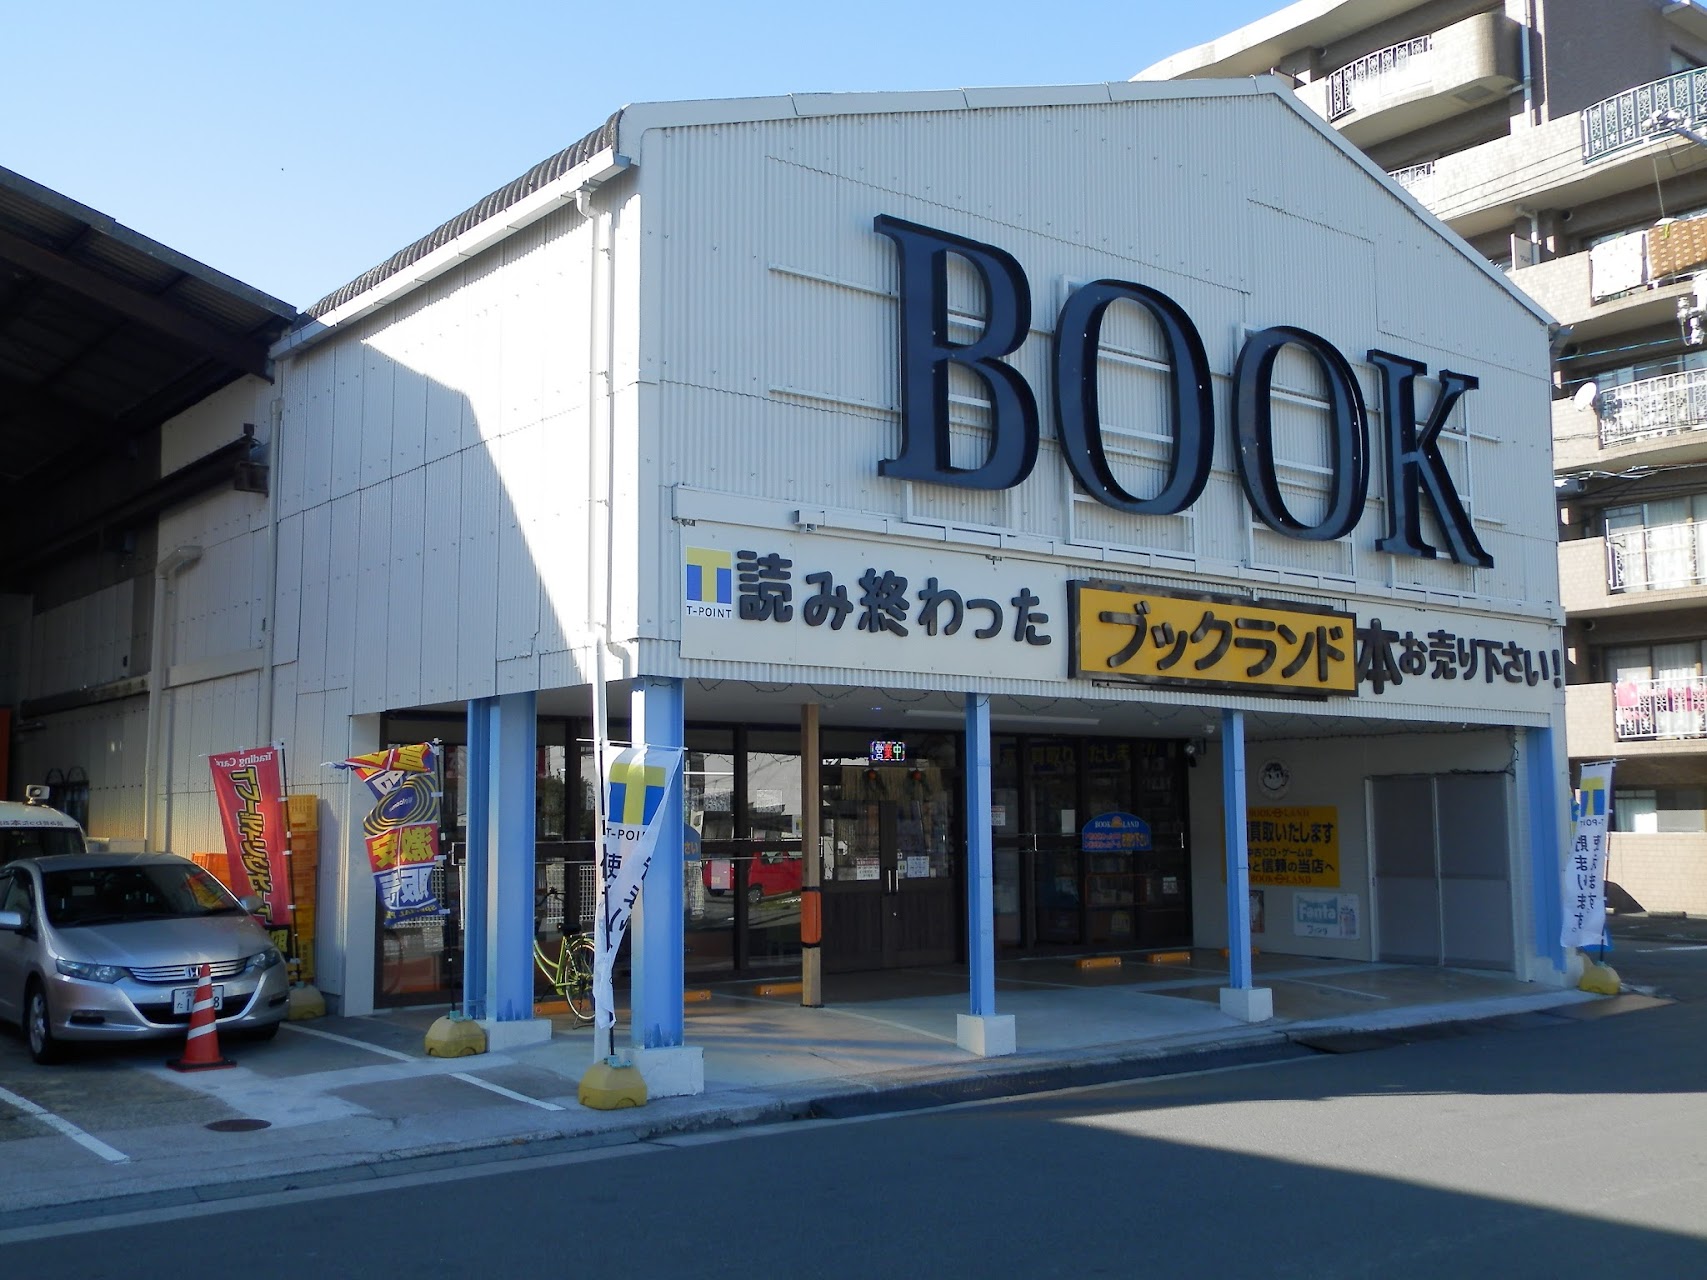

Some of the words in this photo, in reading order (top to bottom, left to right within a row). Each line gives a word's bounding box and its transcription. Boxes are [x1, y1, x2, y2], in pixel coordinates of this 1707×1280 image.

[873, 213, 1494, 569] BOOK
[736, 549, 1052, 646] 読み終わった
[686, 605, 732, 620] T-POINT
[1099, 600, 1345, 683] ブックランド
[875, 743, 902, 760] 営業中
[1095, 820, 1111, 828] BOOK
[1247, 820, 1334, 844] 買取いたします
[1248, 858, 1335, 873] と信頼の当店へ
[1298, 902, 1337, 920] Fanta
